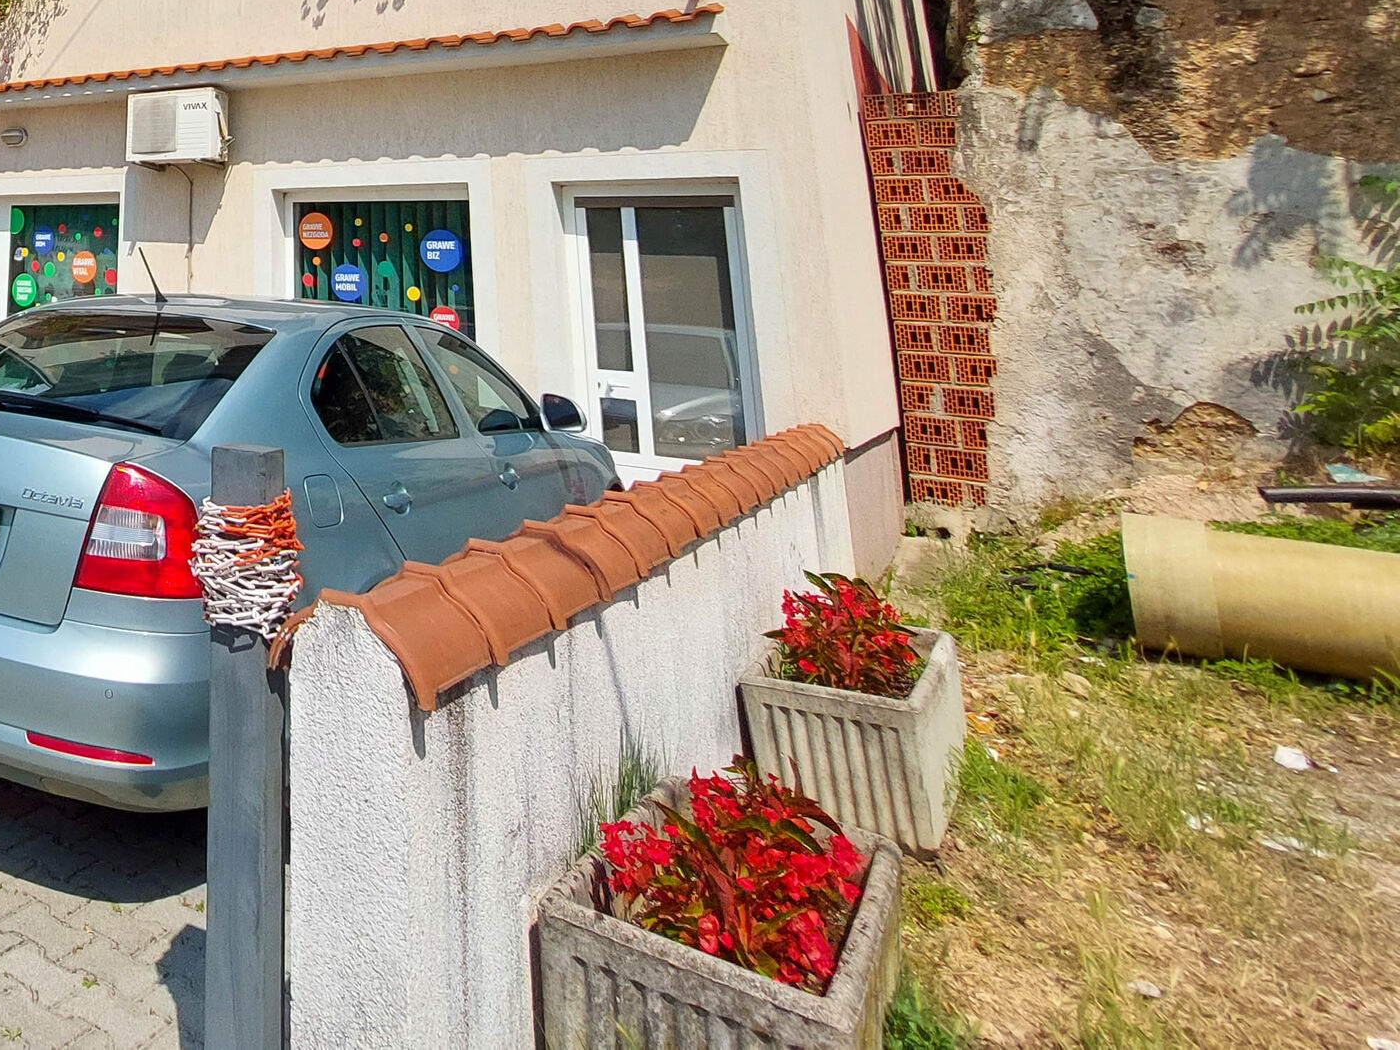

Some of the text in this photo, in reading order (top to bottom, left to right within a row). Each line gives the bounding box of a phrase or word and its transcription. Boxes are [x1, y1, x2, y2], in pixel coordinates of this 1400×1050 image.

[183, 102, 208, 110] VIVAX
[426, 241, 456, 250] GRAWE
[426, 251, 440, 260] BIZ
[335, 273, 360, 282] GRAWE
[335, 283, 358, 292] MOBIL
